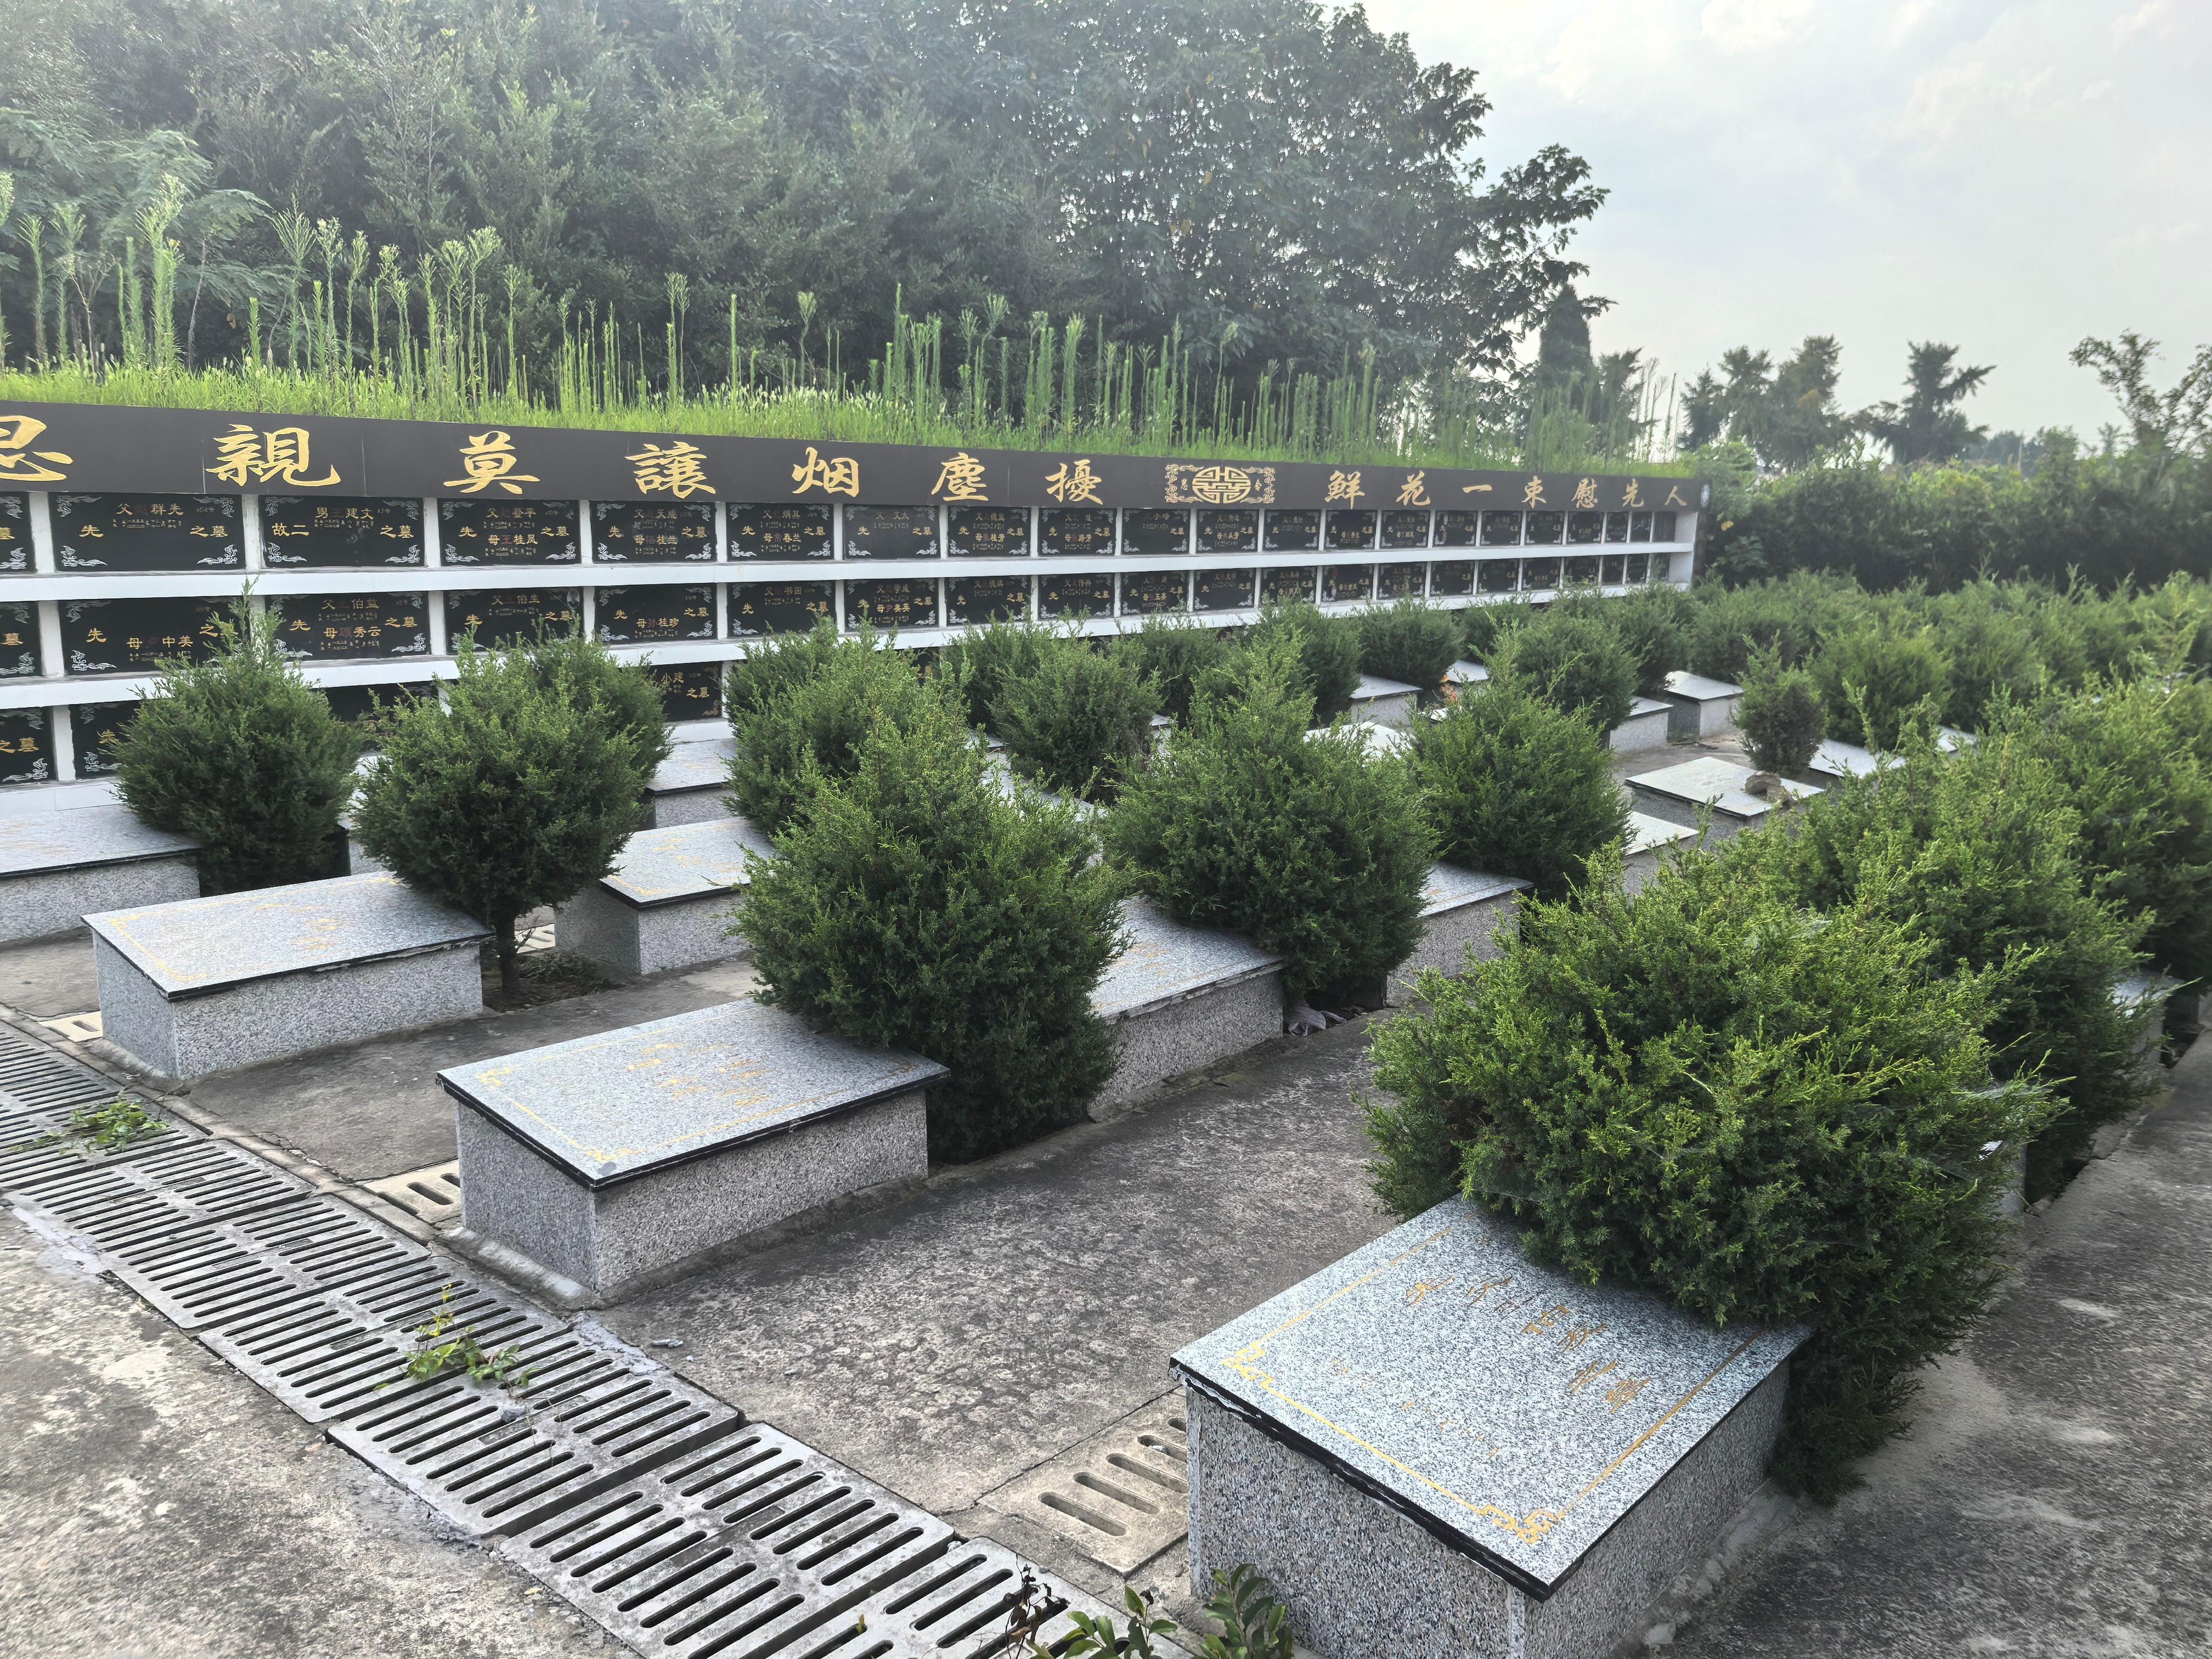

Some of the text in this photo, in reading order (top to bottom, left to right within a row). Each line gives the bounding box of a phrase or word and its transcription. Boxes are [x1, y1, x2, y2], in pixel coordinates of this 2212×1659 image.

[380, 525, 414, 538] 之墓
[541, 526, 569, 536] 之墓
[682, 527, 707, 537] 之墓
[385, 617, 417, 628] 之墓
[687, 687, 710, 698] 之墓
